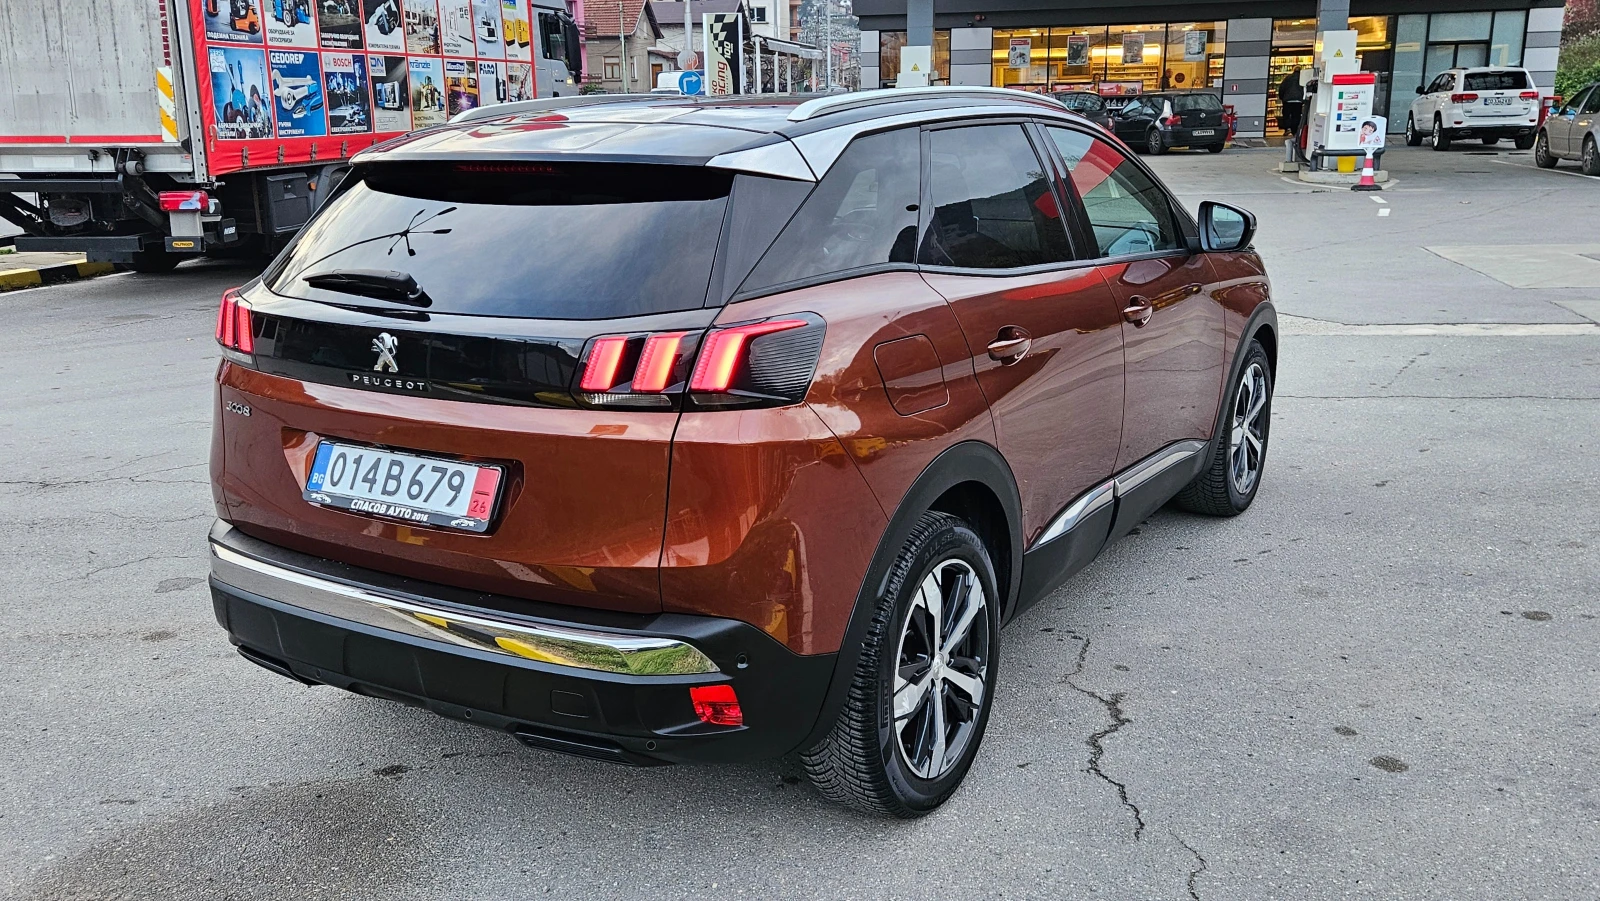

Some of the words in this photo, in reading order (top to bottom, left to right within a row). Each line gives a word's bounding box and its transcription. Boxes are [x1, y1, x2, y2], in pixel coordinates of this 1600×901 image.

[270, 52, 300, 64] GEDORE
[724, 41, 732, 59] 100
[332, 58, 352, 67] BOSCH
[718, 62, 728, 94] acing
[352, 374, 425, 390] PEUGEOT
[226, 400, 251, 416] 3008
[312, 472, 324, 484] BG
[330, 452, 465, 507] 014B679
[351, 499, 386, 514] СПАСОВ
[388, 506, 412, 518] АУТО
[412, 512, 429, 522] 2016
[470, 500, 486, 514] 26
